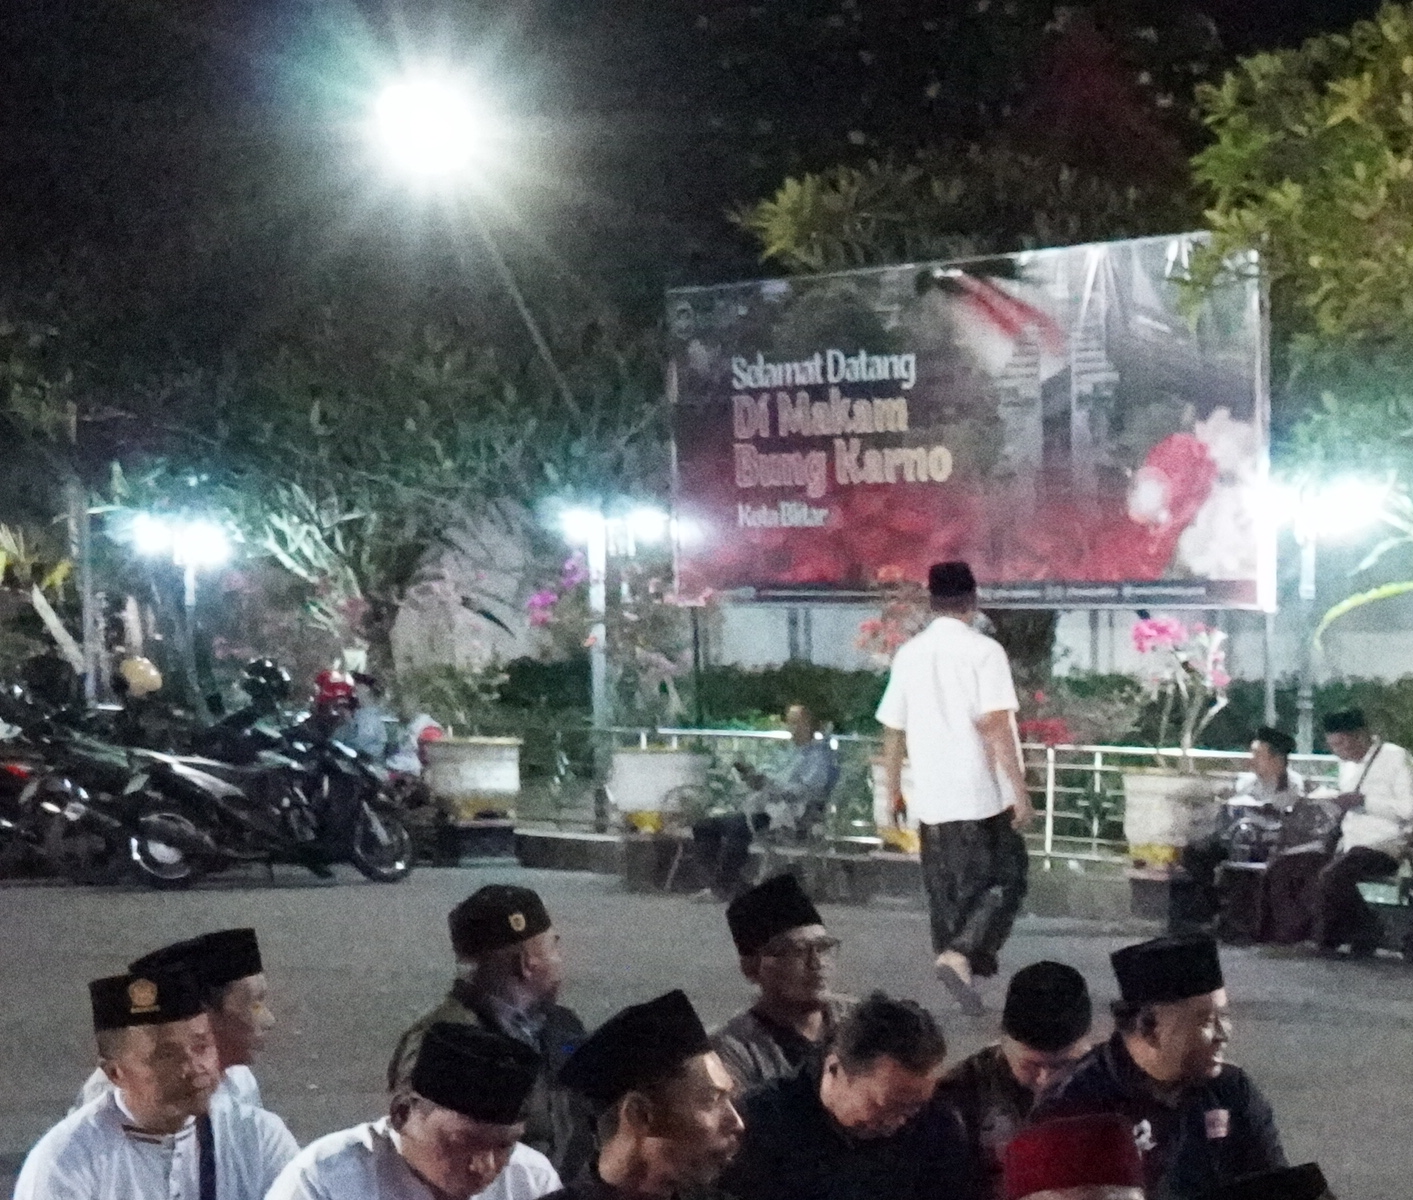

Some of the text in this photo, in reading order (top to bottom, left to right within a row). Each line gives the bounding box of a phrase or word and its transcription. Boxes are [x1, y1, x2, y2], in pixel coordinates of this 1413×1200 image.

[732, 349, 916, 390] Selamat Datang
[733, 386, 909, 439] Di Makam
[733, 437, 953, 498] Bung Karno
[738, 503, 778, 527] Kota
